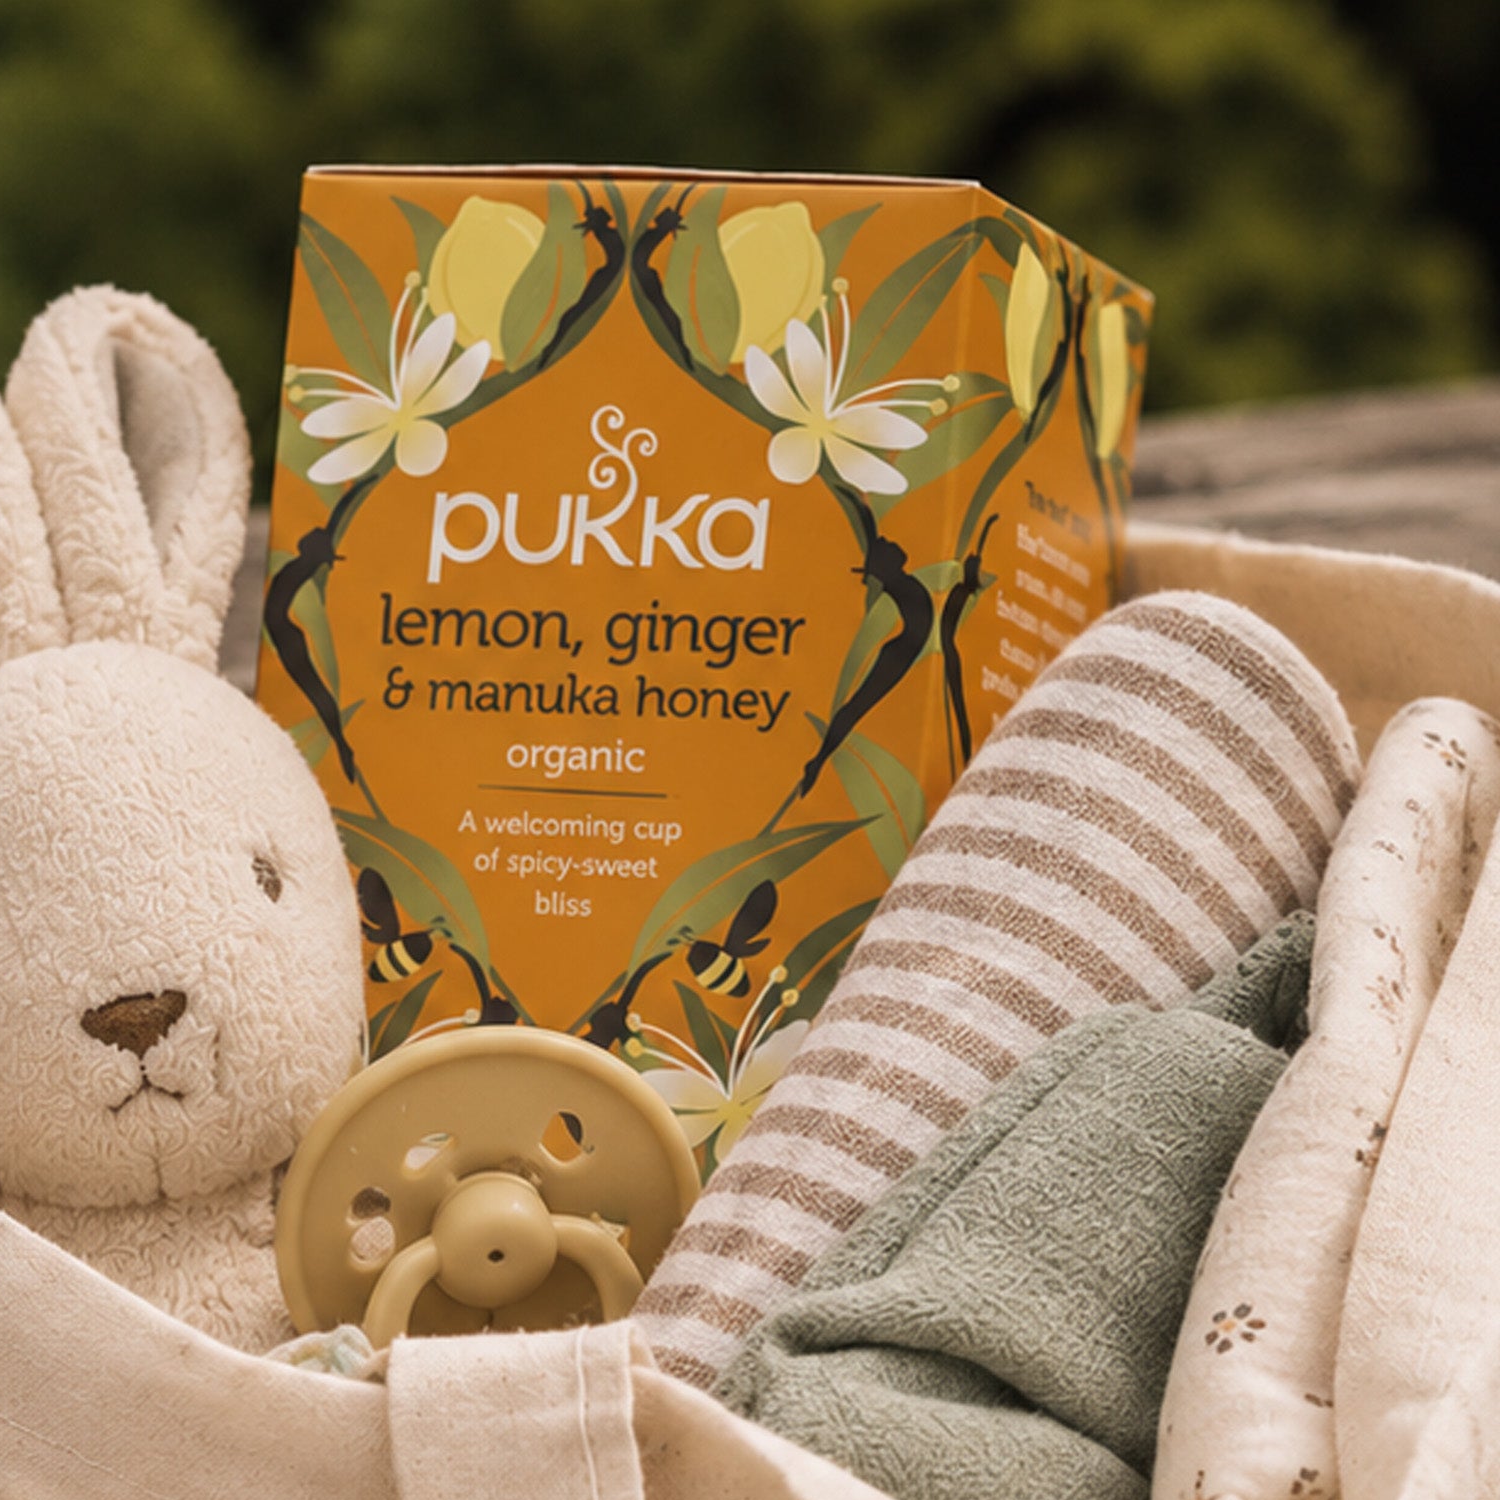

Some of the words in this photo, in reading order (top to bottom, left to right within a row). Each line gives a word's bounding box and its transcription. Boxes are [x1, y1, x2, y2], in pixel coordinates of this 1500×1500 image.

[426, 404, 771, 584] pukka
[380, 592, 584, 658] lemon,
[605, 599, 806, 669] ginger
[382, 665, 415, 711] &
[428, 672, 620, 717] manuka
[635, 674, 792, 733] honey
[506, 738, 646, 779] organic
[457, 809, 478, 834] A
[483, 810, 626, 846] welcoming
[633, 820, 683, 847] cup
[473, 846, 501, 873] of
[506, 849, 659, 882] spicy-sweet
[534, 889, 593, 918] bliss
